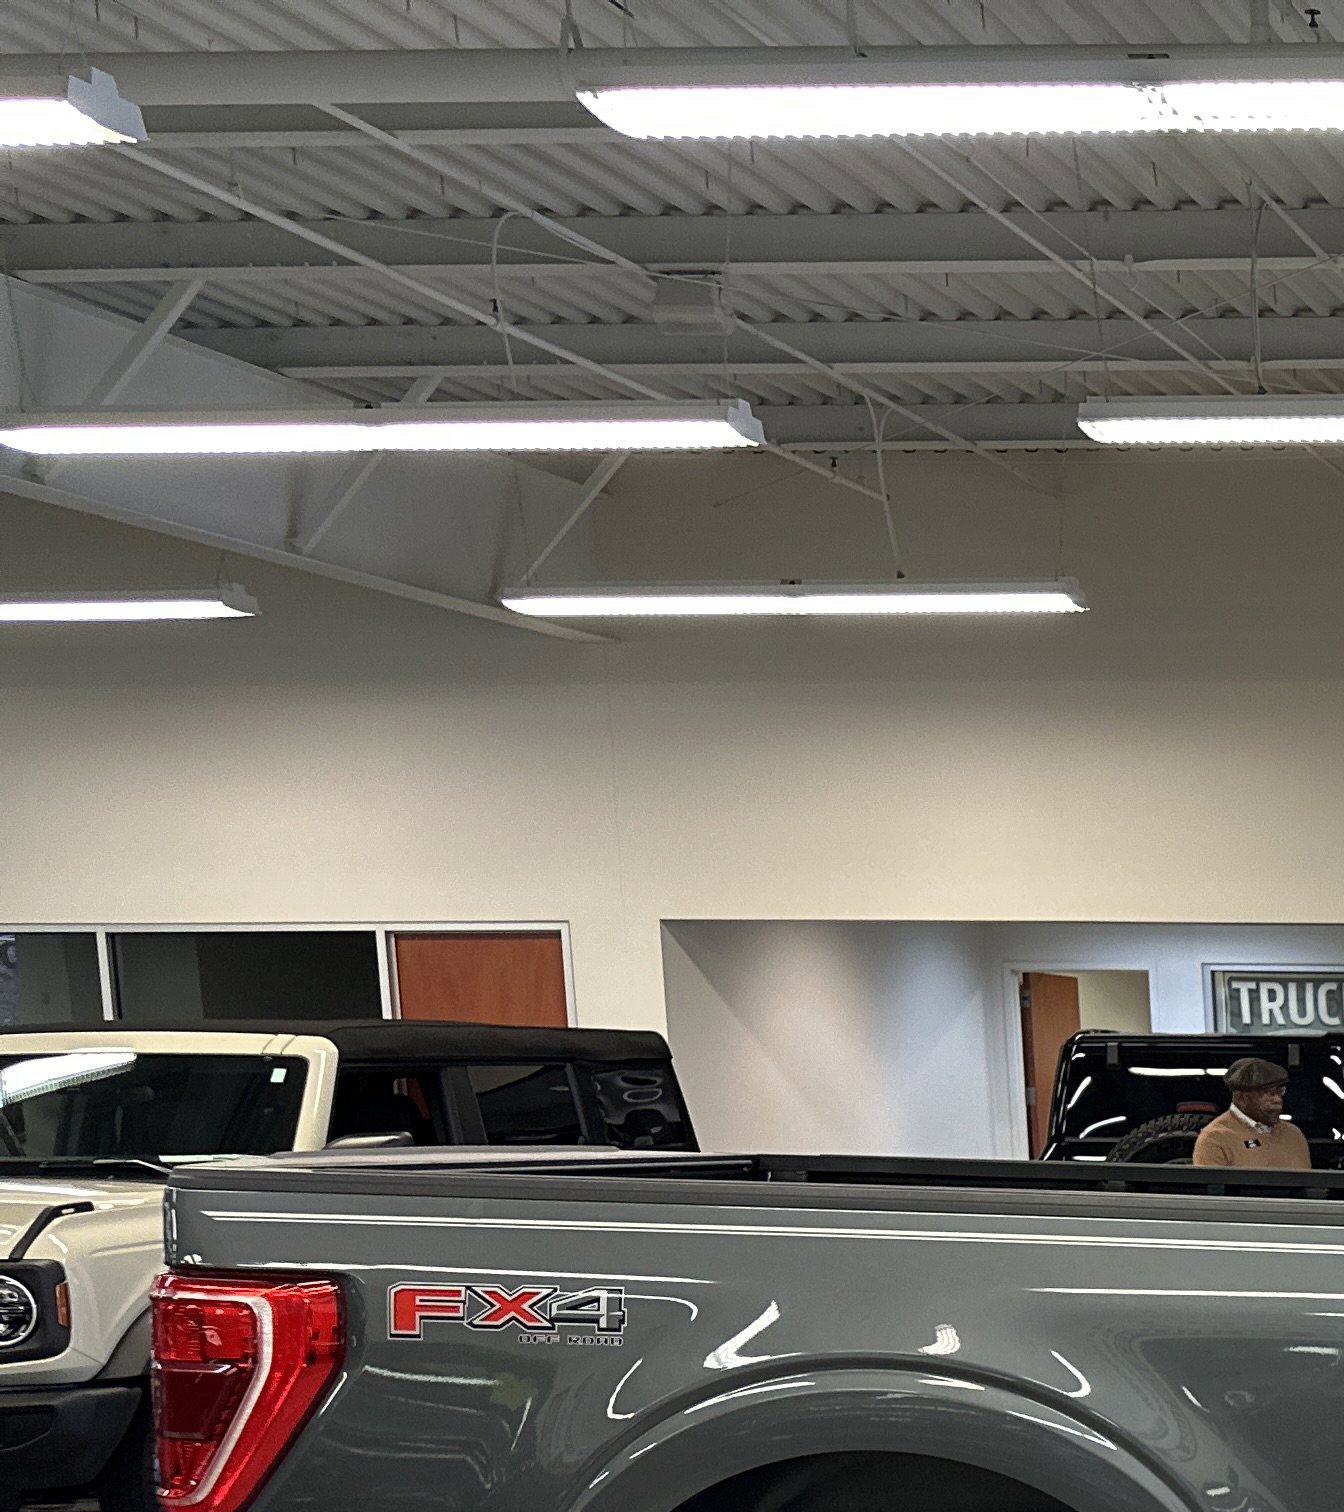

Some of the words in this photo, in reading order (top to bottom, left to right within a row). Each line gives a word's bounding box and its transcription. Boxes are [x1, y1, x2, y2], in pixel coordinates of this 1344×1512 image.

[387, 1281, 628, 1341] FX4
[517, 1333, 561, 1344] OFF
[567, 1335, 623, 1346] ROAD
